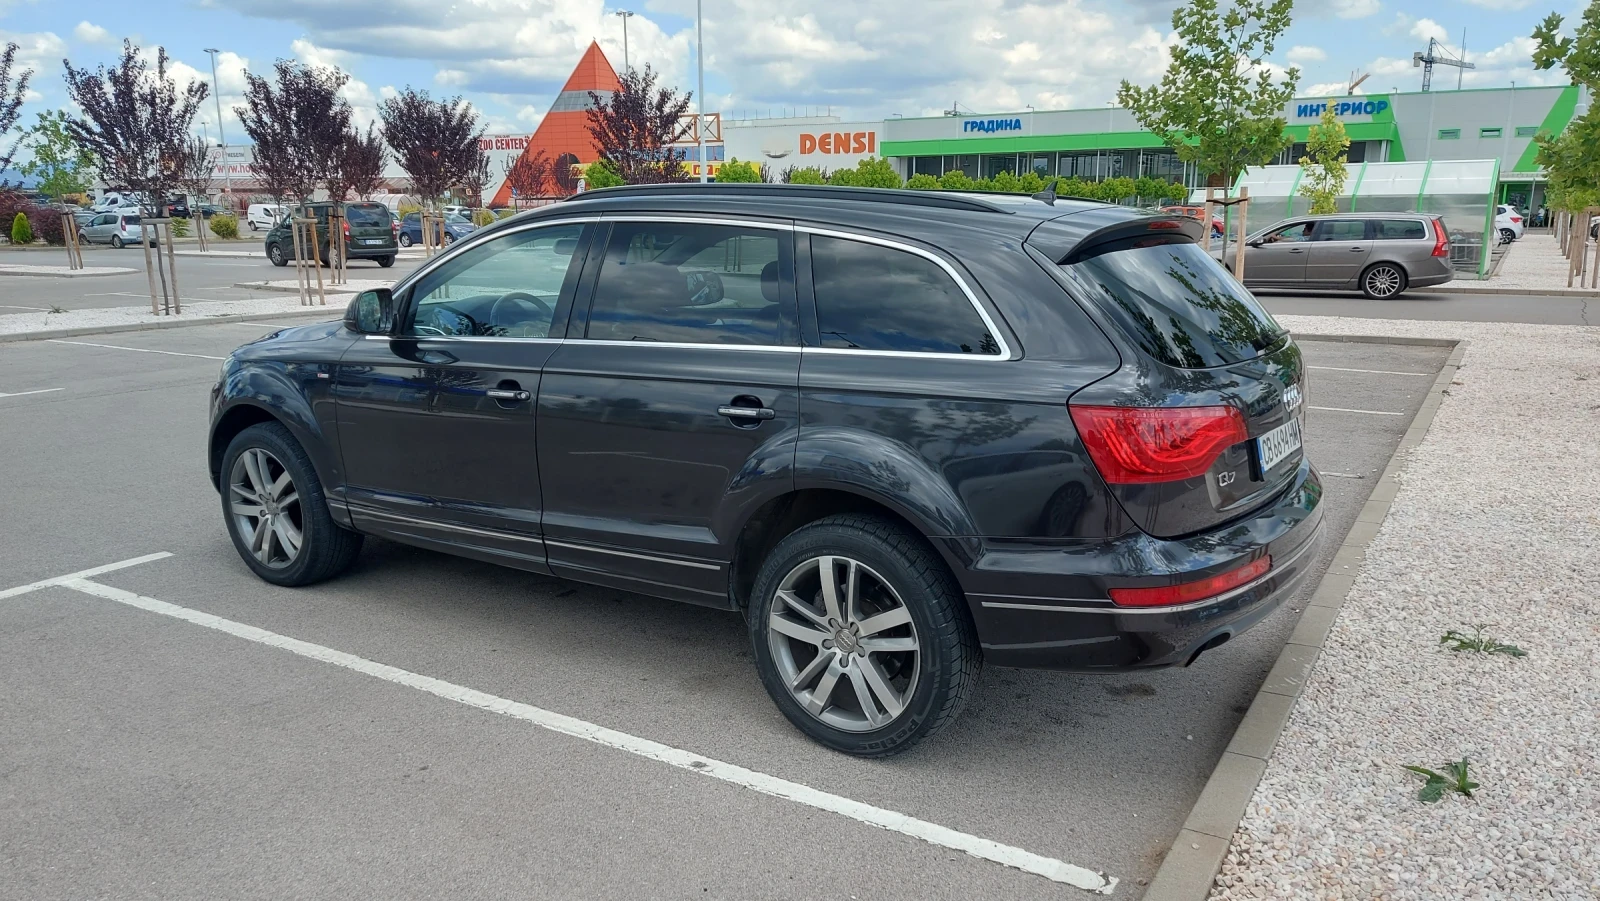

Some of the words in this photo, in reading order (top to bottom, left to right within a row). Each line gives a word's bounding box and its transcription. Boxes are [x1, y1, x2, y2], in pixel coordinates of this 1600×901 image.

[963, 118, 1022, 133] ГРАДИНА
[479, 139, 493, 151] ZOO
[495, 138, 525, 150] CENTER
[799, 131, 876, 155] DENSI
[1218, 471, 1236, 487] Q7
